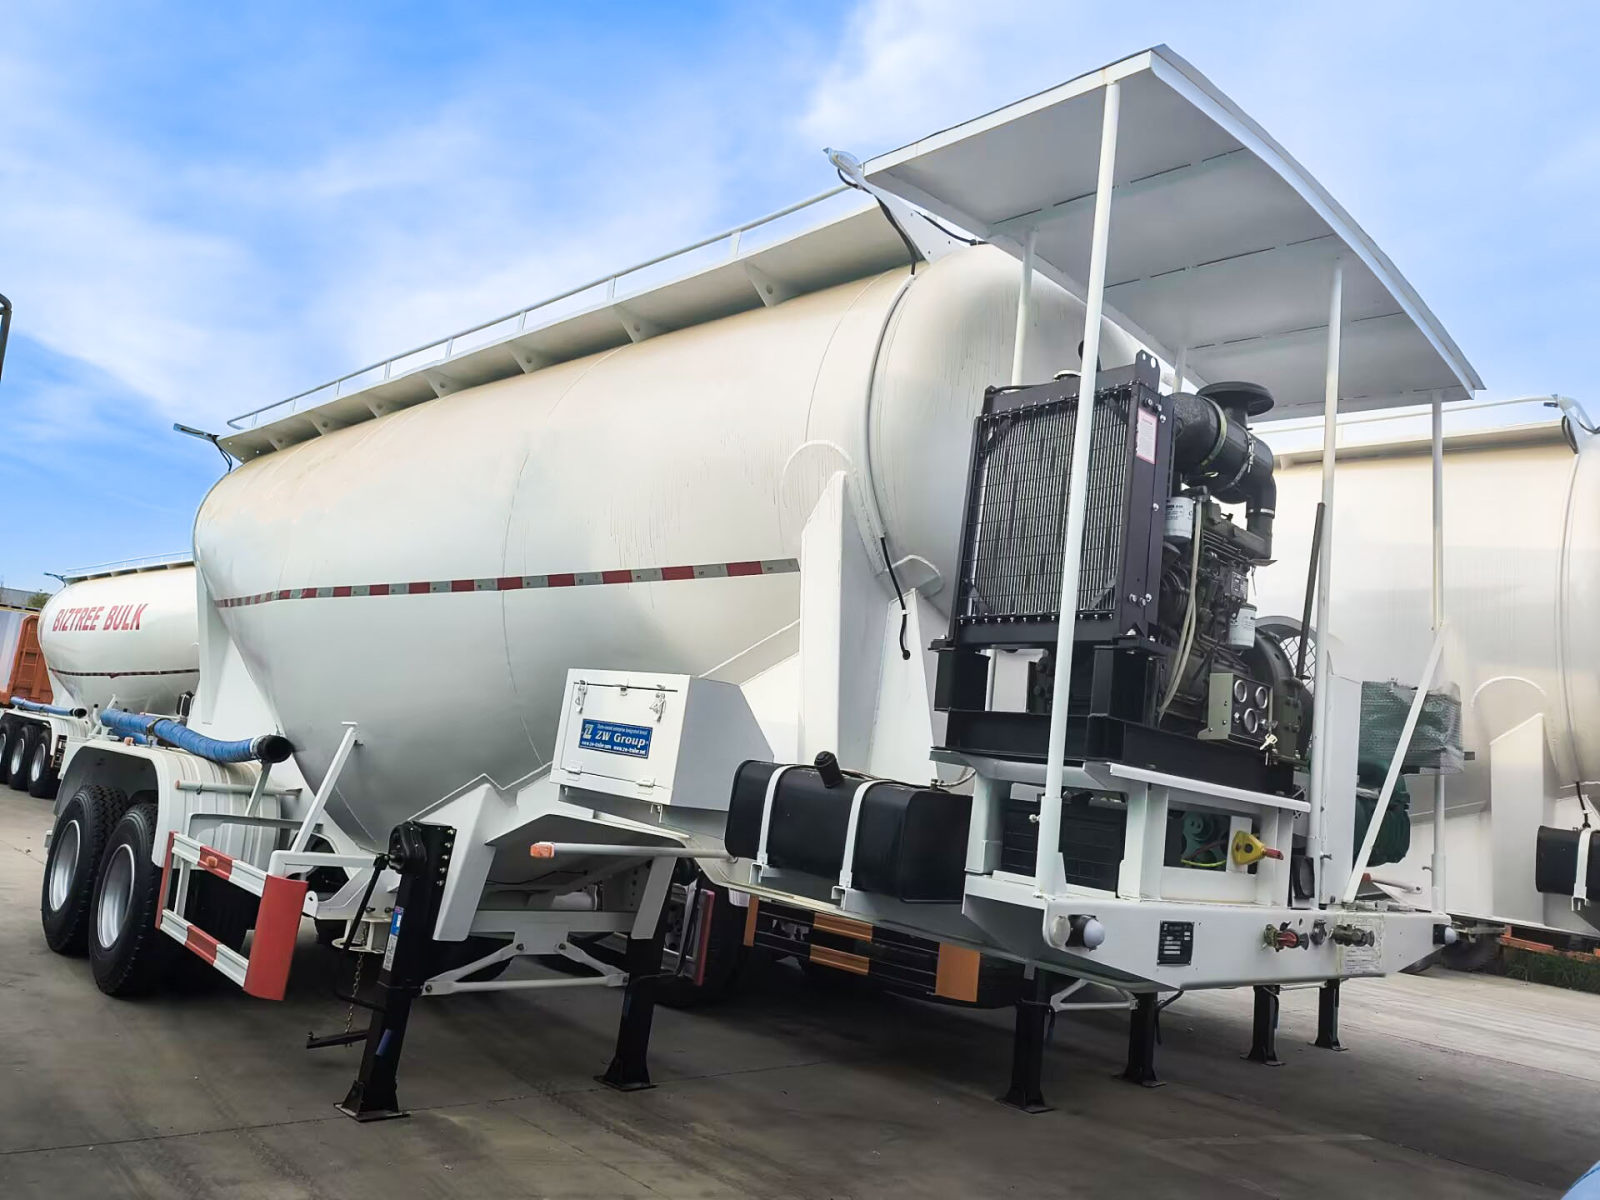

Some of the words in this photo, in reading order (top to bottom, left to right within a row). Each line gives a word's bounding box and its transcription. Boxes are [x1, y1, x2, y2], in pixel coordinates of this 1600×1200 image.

[52, 606, 105, 632] BIZTREE
[102, 603, 148, 631] BULK
[595, 730, 611, 741] ZW
[613, 733, 646, 748] Group
